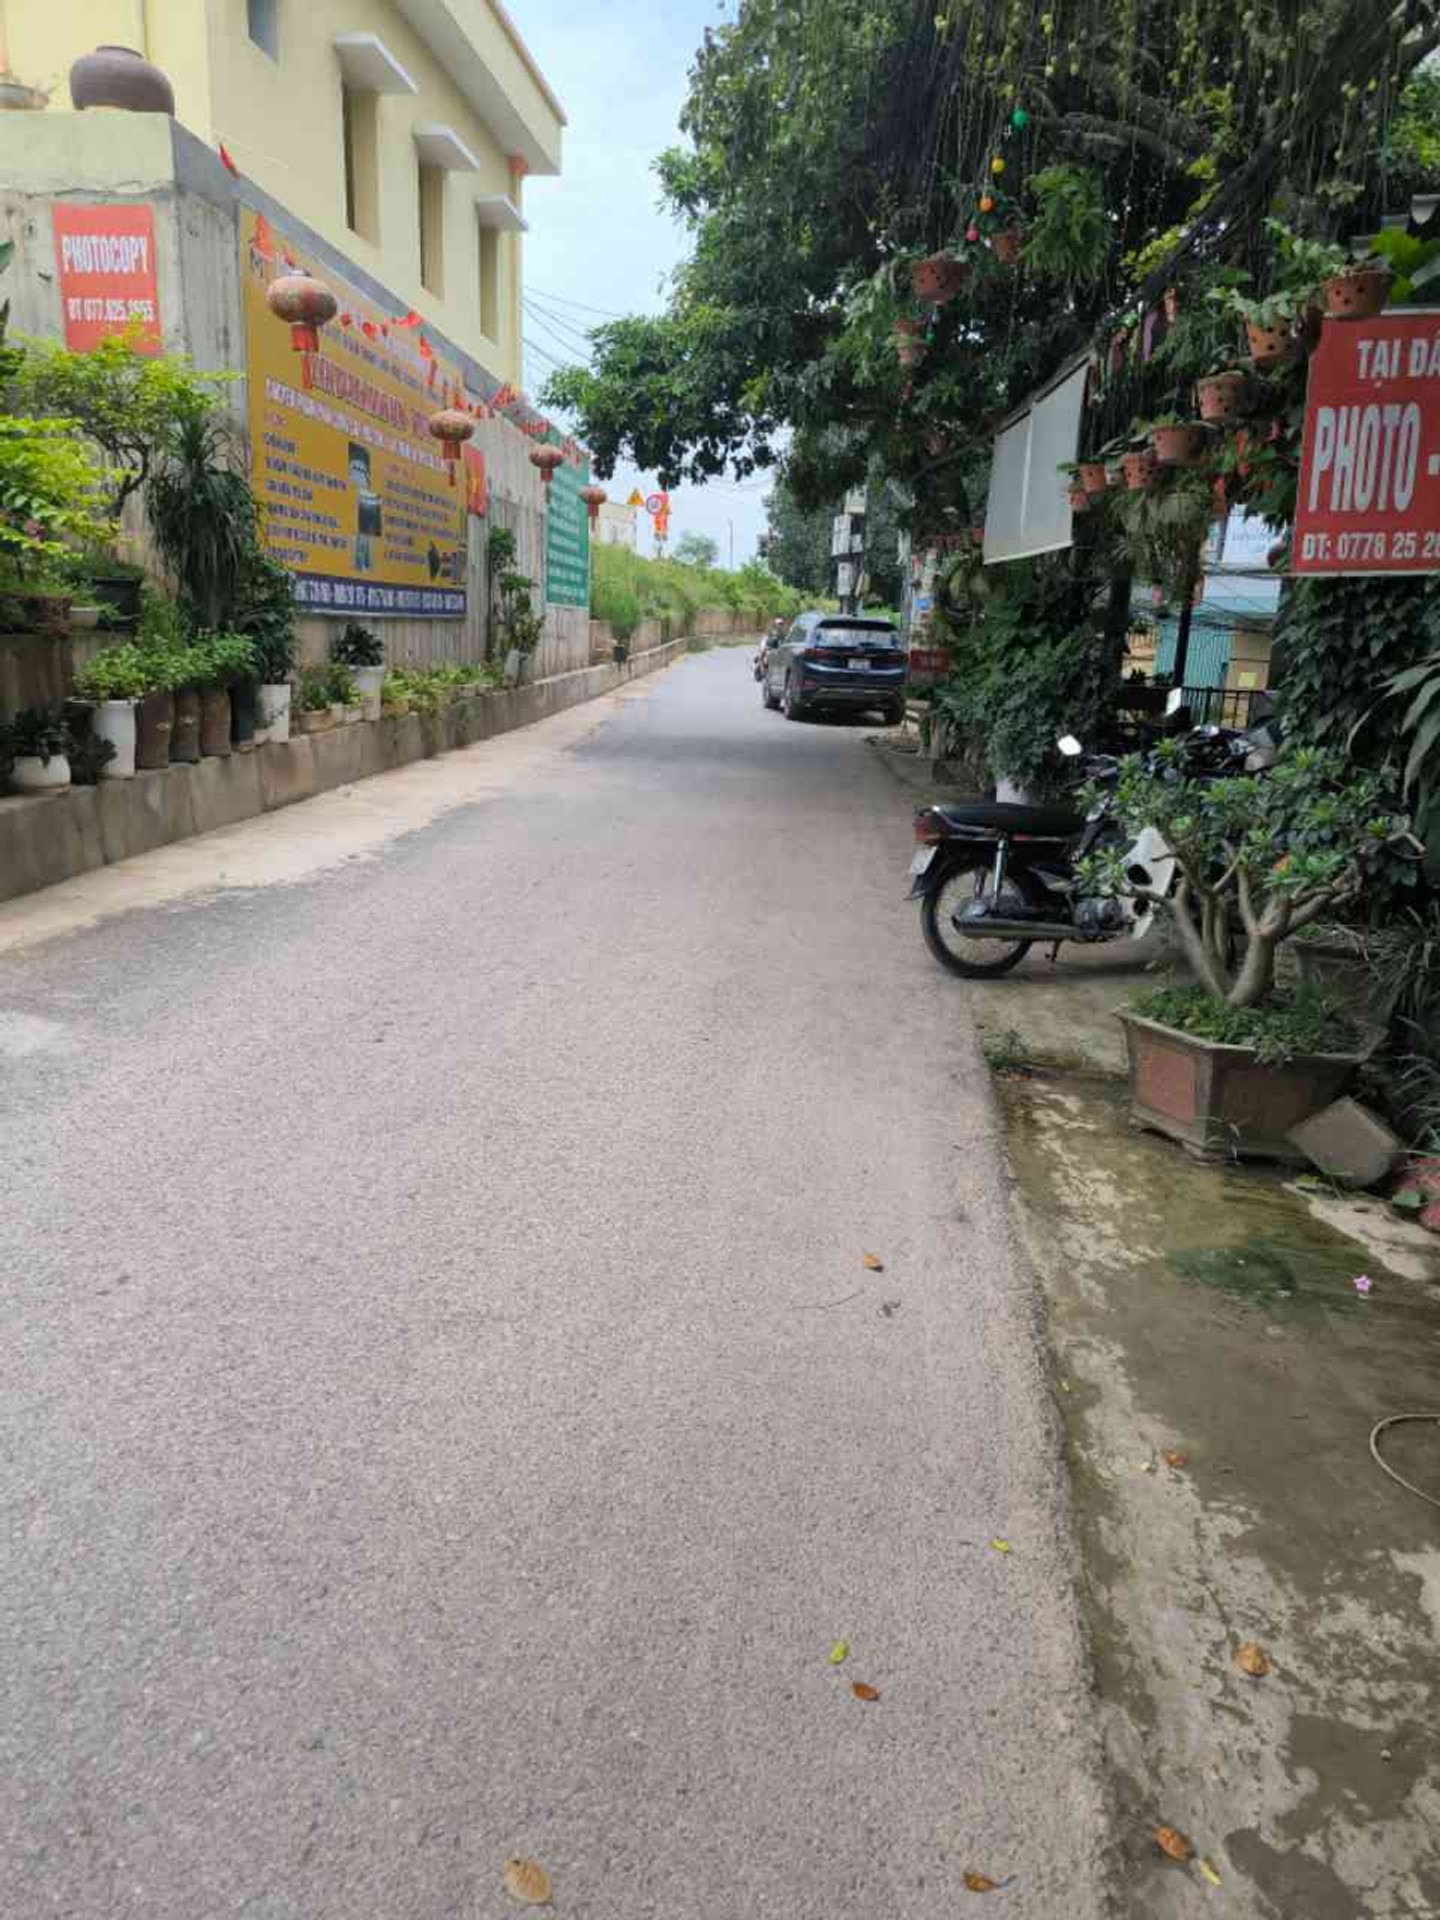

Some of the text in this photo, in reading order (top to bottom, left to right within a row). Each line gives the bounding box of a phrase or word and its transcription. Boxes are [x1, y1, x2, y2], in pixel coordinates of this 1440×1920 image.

[62, 235, 148, 273] PHOTOCOPY
[1357, 337, 1401, 388] TẠI
[1308, 404, 1421, 512] PHOTO
[1391, 530, 1418, 559] 25
